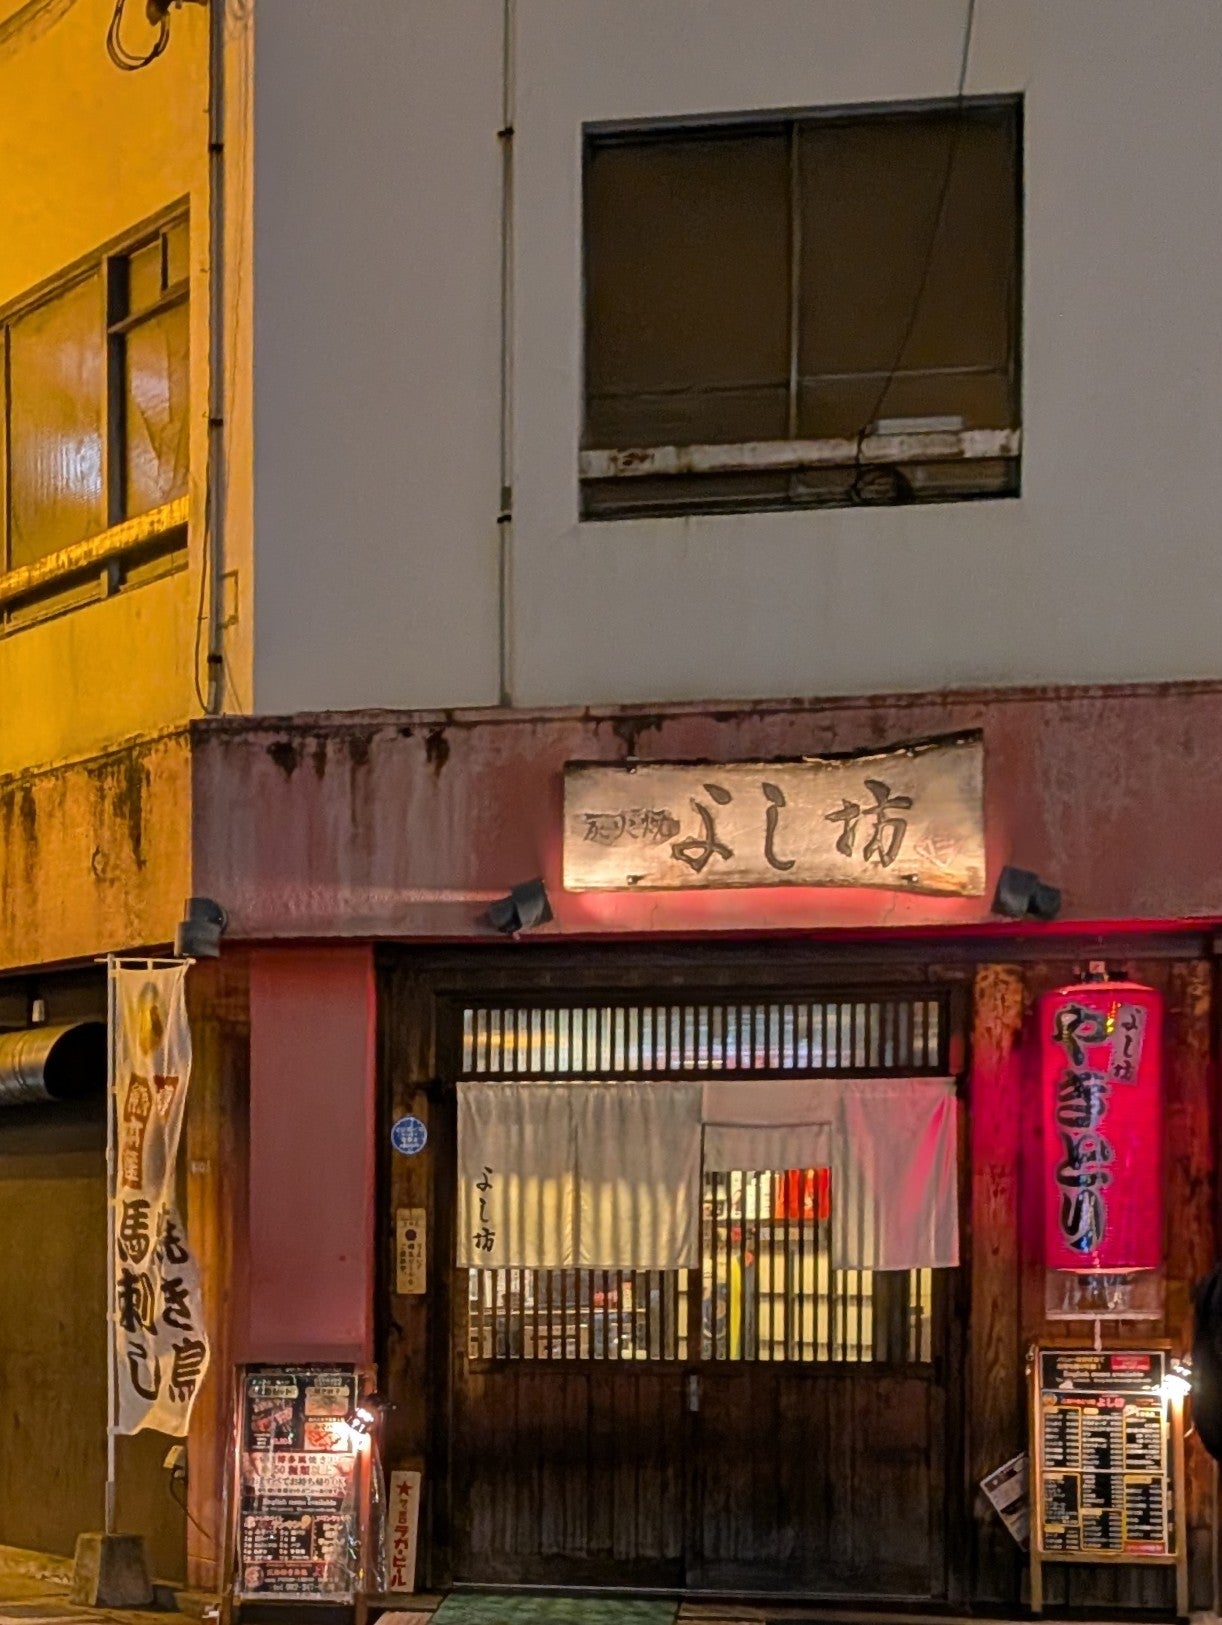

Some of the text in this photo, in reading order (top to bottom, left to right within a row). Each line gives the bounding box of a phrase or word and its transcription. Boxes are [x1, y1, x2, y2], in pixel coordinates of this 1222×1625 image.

[671, 779, 914, 873] よし坊
[473, 1167, 496, 1252] よし坊
[117, 1199, 161, 1401] 馬刺し
